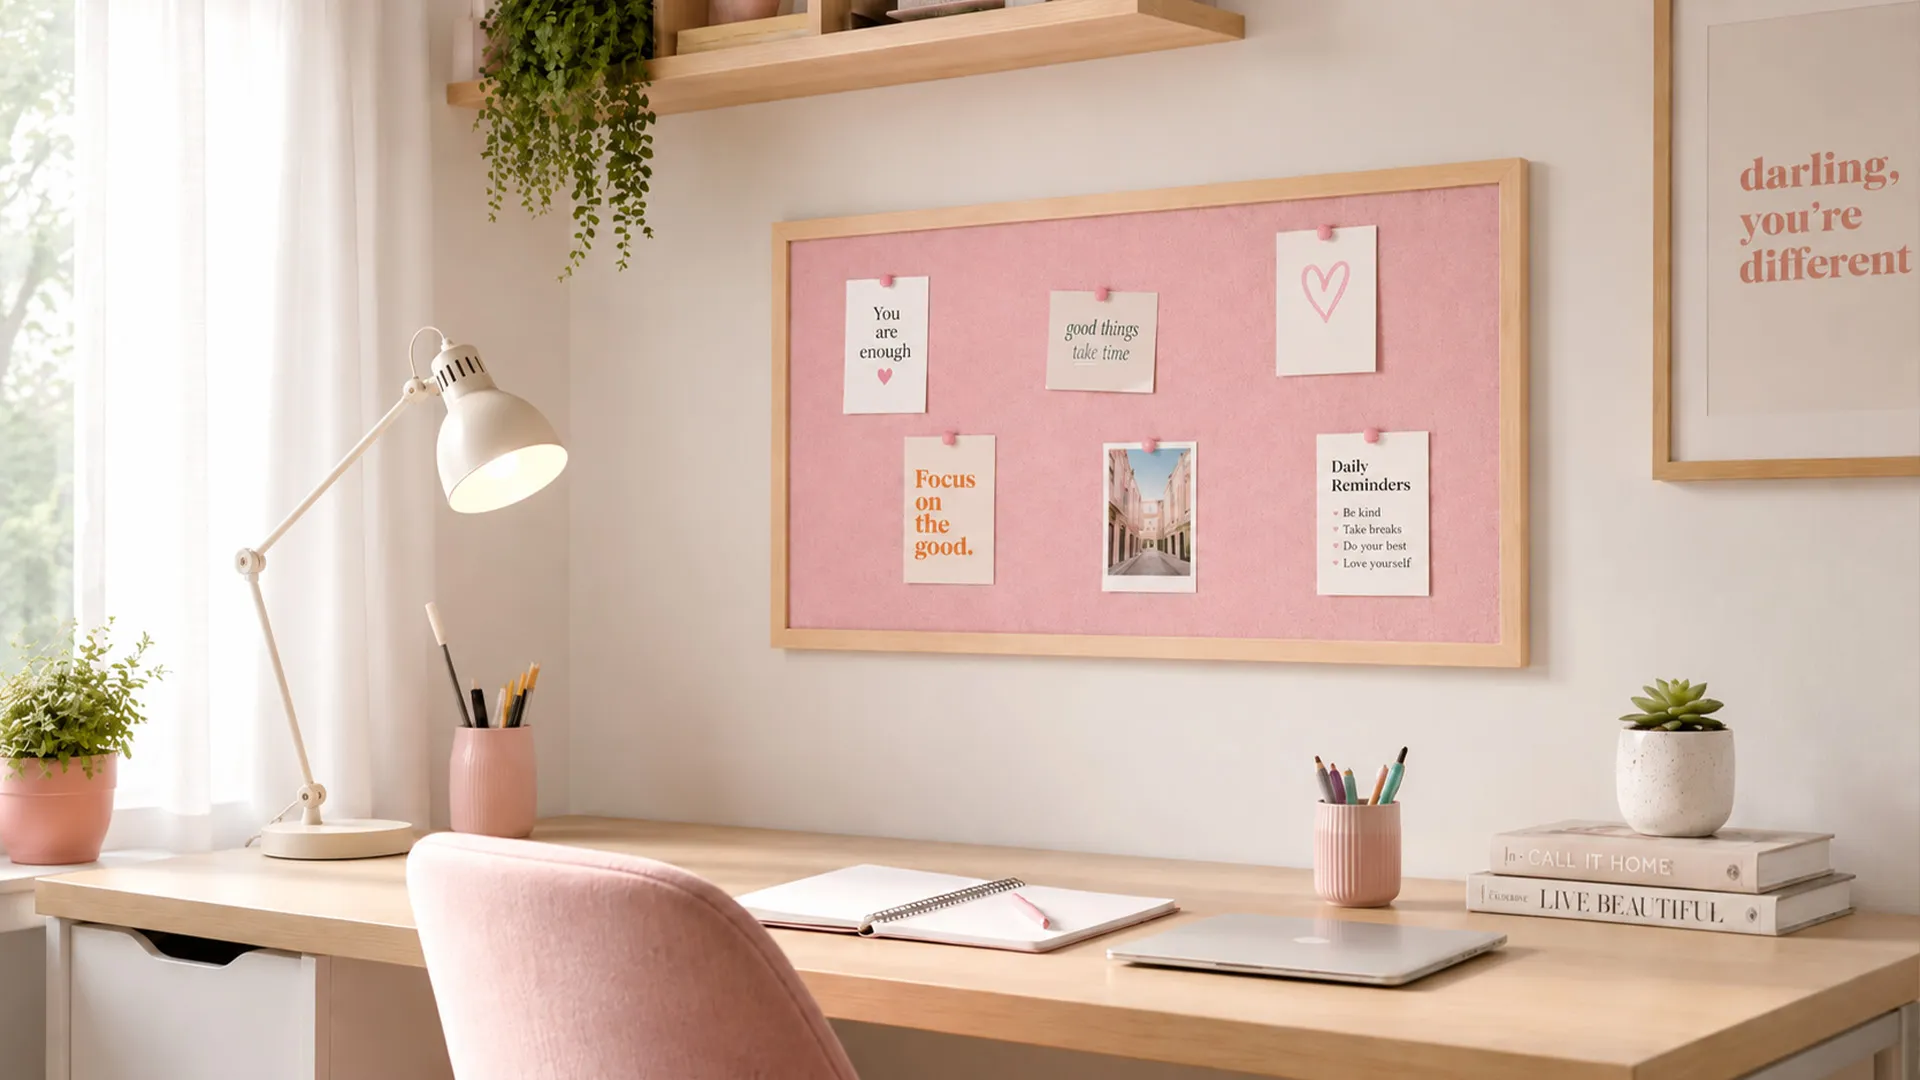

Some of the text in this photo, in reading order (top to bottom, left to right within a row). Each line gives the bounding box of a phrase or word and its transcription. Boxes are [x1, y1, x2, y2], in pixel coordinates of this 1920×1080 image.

[1739, 151, 1900, 191] darling,
[1739, 201, 1863, 246] you're
[1739, 244, 1914, 285] different
[873, 306, 901, 321] You
[875, 327, 899, 339] are
[1064, 318, 1140, 342] good things
[859, 342, 912, 362] enough
[1072, 342, 1131, 361] take time
[1331, 459, 1369, 475] Daily
[915, 469, 976, 489] Focus
[1331, 477, 1412, 493] Reminders
[915, 496, 942, 511] on
[1343, 507, 1382, 518] Be kind
[915, 513, 950, 534] the
[1342, 524, 1403, 535] Take breaks
[914, 536, 974, 561] good.
[1343, 540, 1407, 553] Do your best
[1343, 557, 1412, 571] Love yourself
[1528, 848, 1577, 869] CALL
[1585, 853, 1604, 871] IT
[1610, 854, 1672, 876] HOME
[1540, 888, 1590, 913] LIVE
[1597, 893, 1725, 924] BEAUTIFUL
